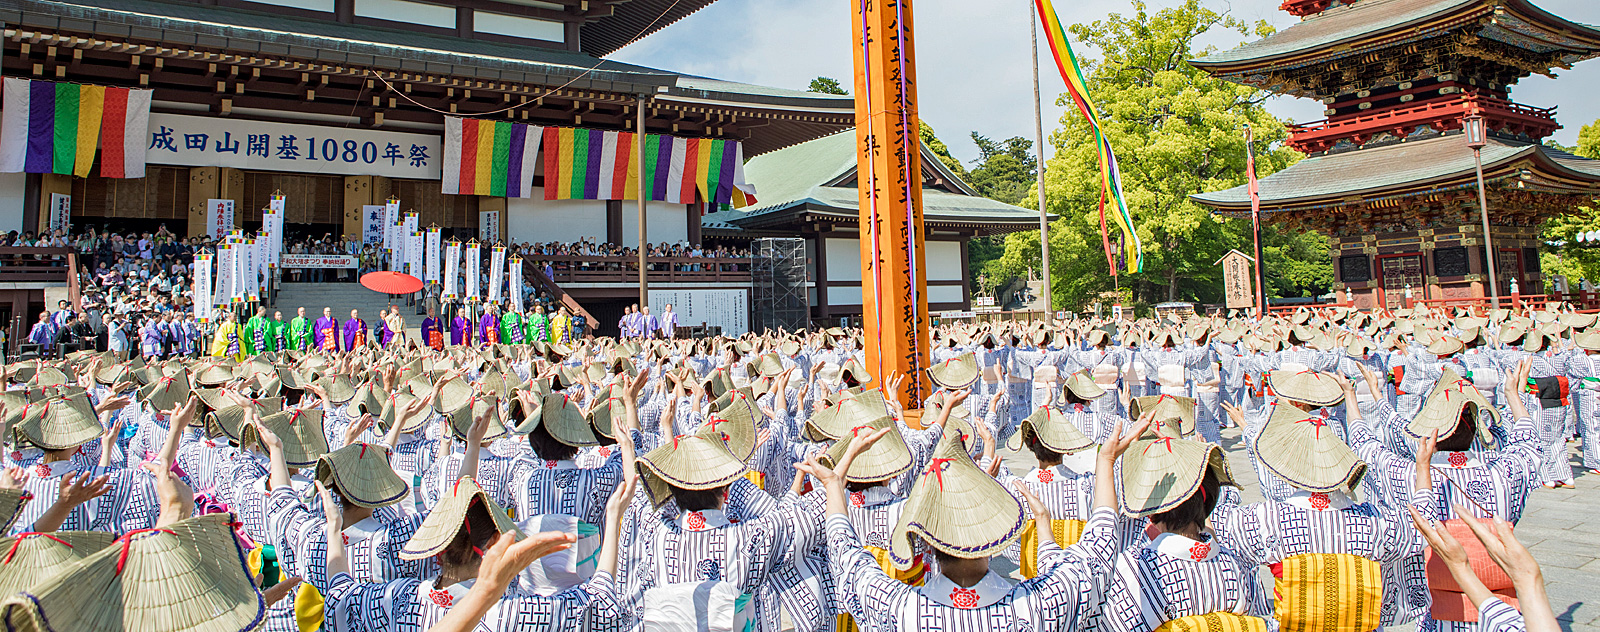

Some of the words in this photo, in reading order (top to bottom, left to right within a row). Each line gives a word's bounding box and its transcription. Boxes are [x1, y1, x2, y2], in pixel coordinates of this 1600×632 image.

[149, 125, 431, 168] 成田山開基1080年祭
